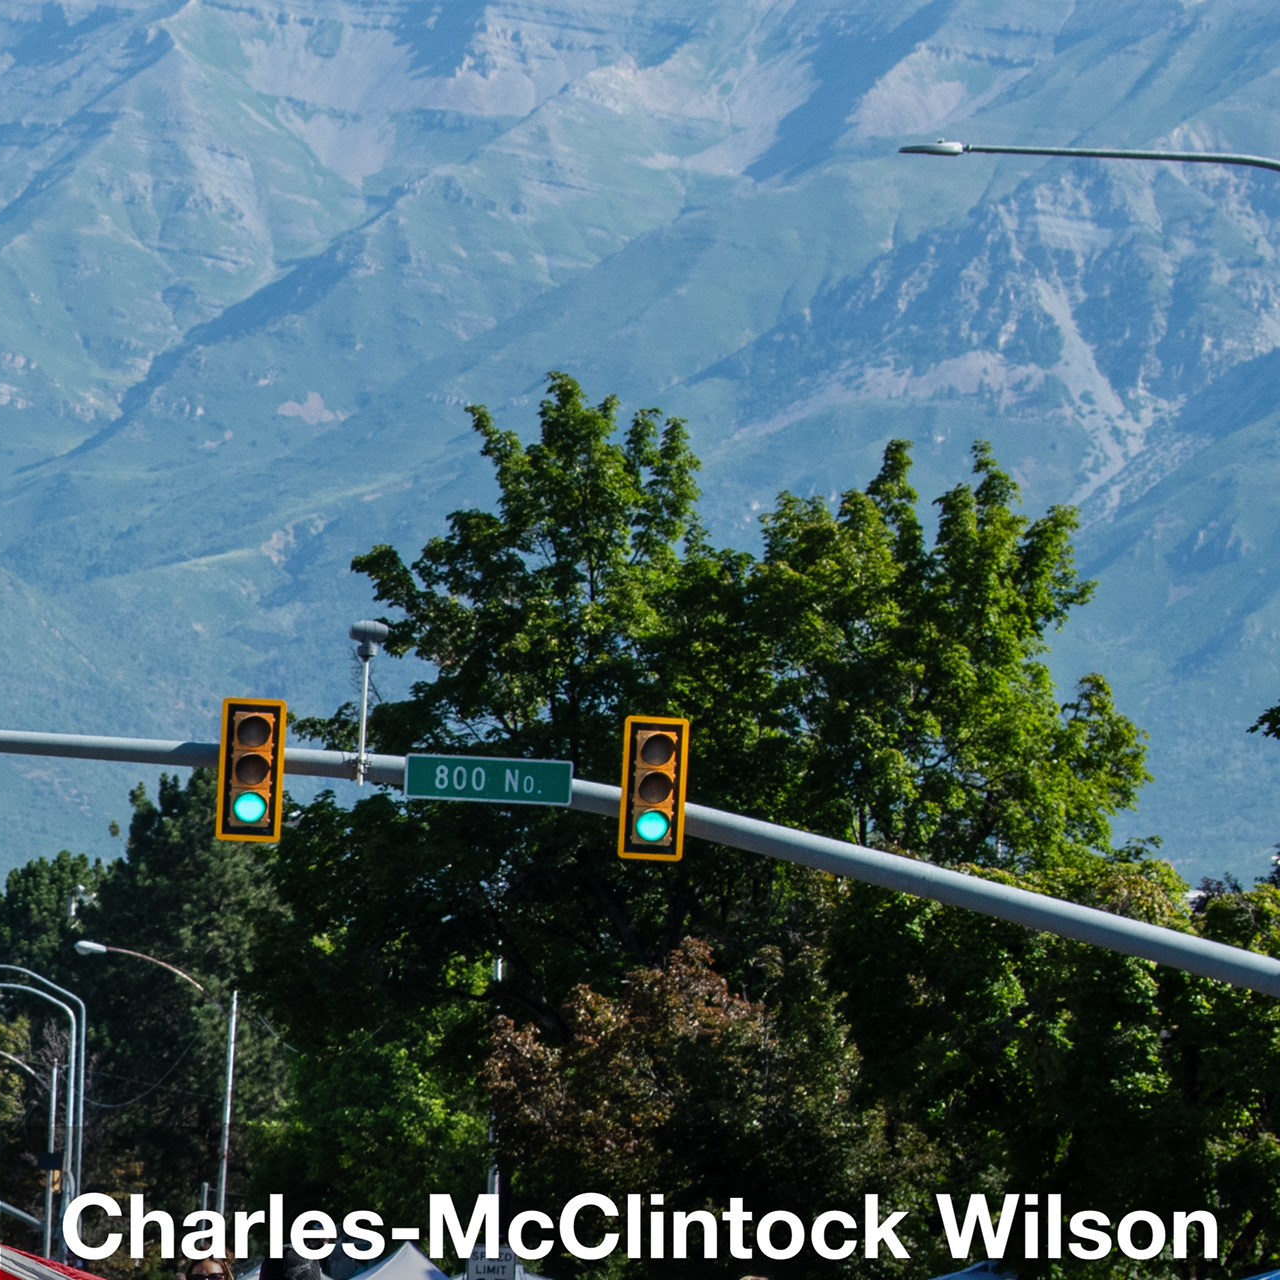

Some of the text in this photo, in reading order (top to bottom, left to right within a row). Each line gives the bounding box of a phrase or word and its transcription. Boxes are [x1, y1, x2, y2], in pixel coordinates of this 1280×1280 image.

[434, 764, 542, 794] 800 No.
[472, 1250, 513, 1262] SPED
[475, 1264, 507, 1276] LIMIT
